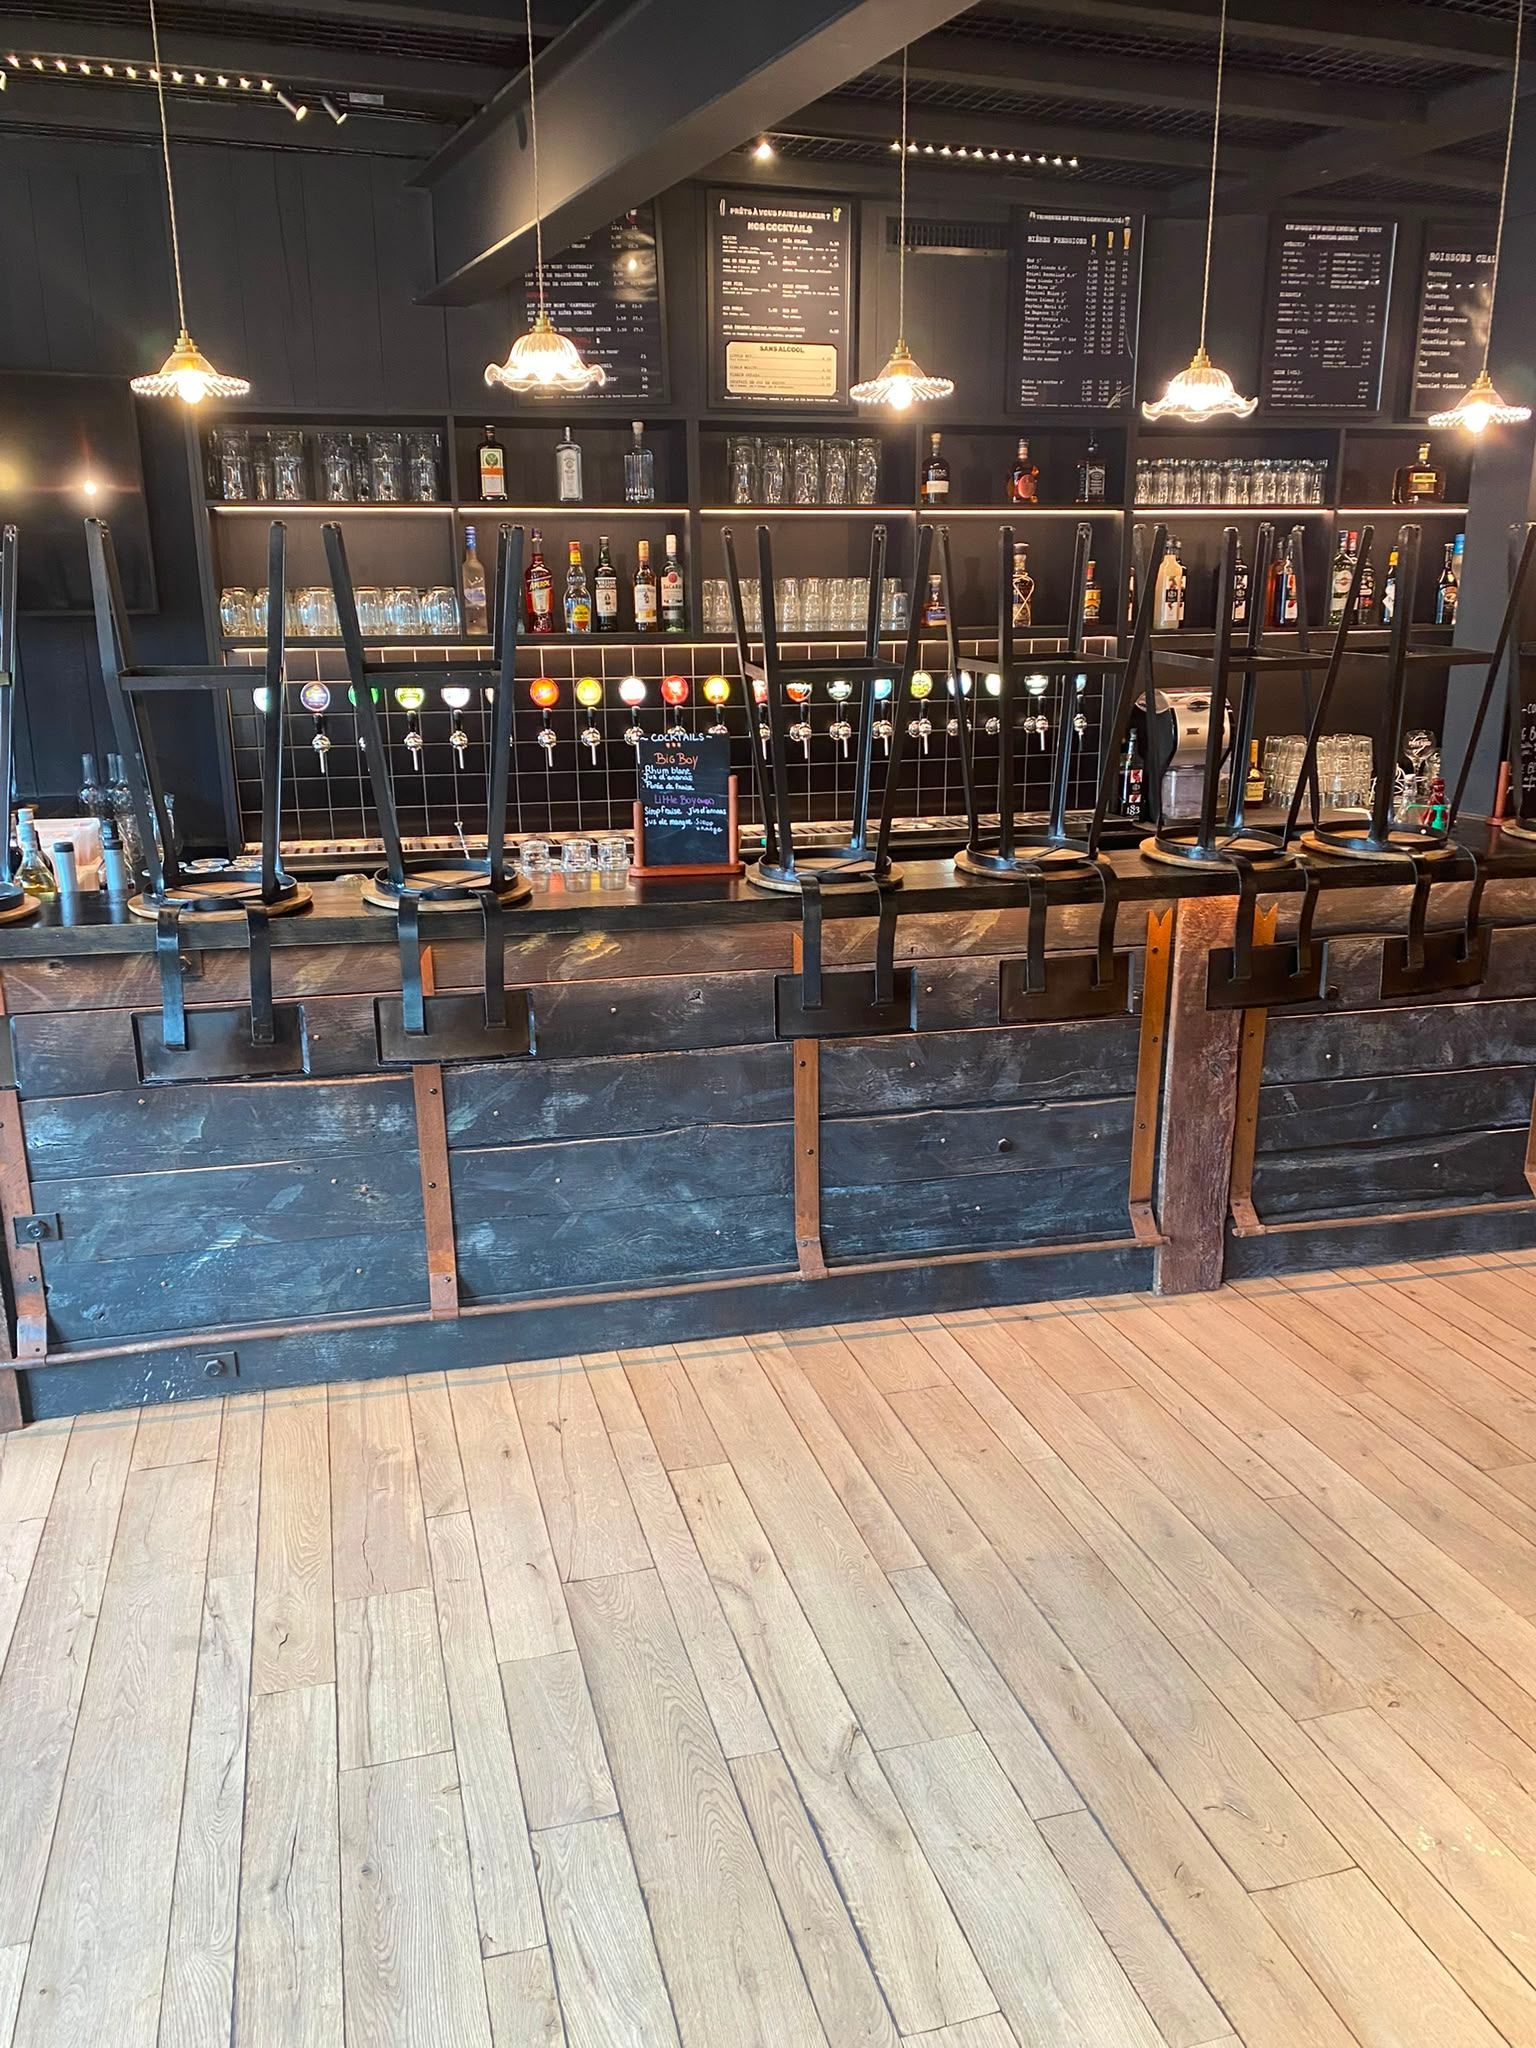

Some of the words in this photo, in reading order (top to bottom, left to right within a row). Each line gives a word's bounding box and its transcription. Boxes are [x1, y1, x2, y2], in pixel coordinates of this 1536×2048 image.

[758, 209, 777, 217] VOUS
[778, 210, 797, 218] FAIRE
[798, 211, 825, 220] SHAKER
[747, 222, 765, 231] NOS
[766, 223, 812, 233] COCKTAILS
[1429, 252, 1472, 263] BOISSONS
[530, 580, 550, 590] APEROL
[650, 733, 704, 742] COCKTAILS
[644, 765, 669, 775] Rhum
